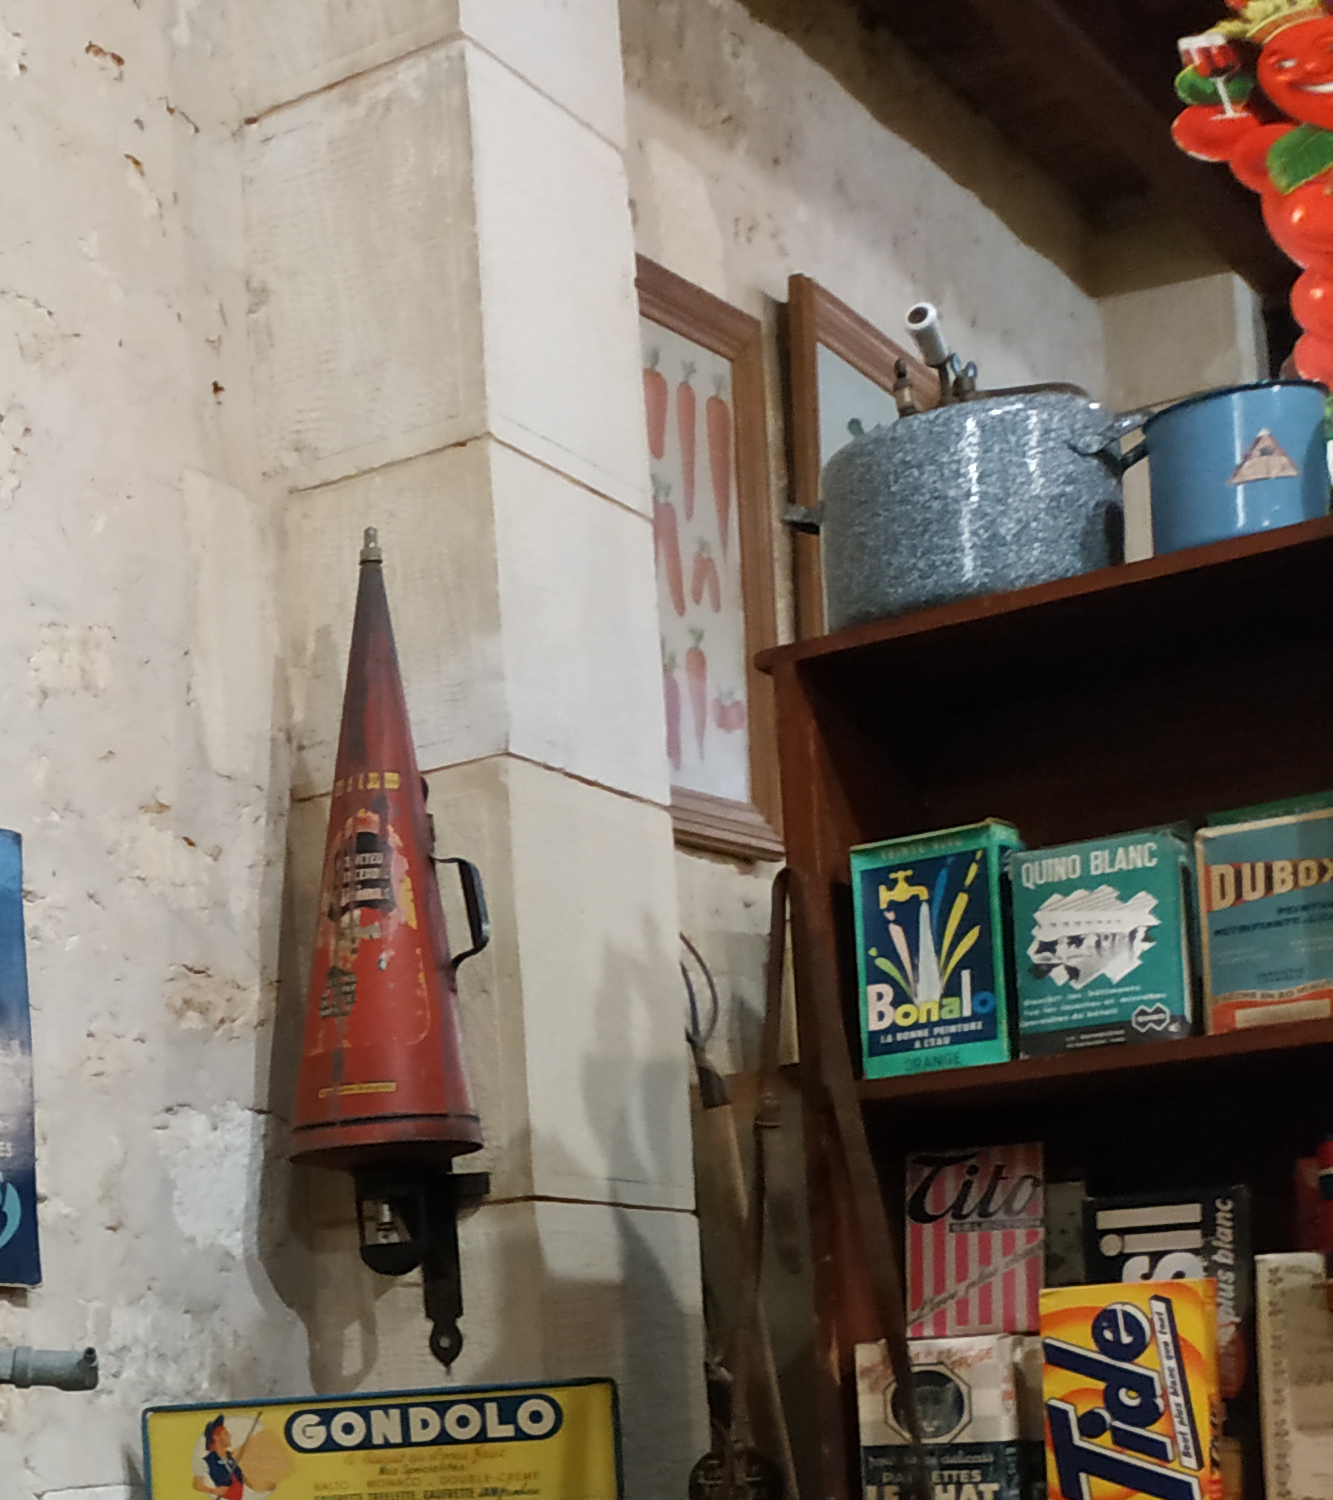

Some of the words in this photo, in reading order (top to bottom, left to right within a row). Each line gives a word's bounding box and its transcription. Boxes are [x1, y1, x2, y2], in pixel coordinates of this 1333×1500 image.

[1021, 854, 1082, 889] QUINO
[1089, 841, 1159, 876] BLANC
[866, 968, 997, 1032] Bonalo
[880, 1033, 894, 1045] LA
[1211, 1197, 1235, 1266] blanc
[290, 1397, 557, 1450] GONDOLO
